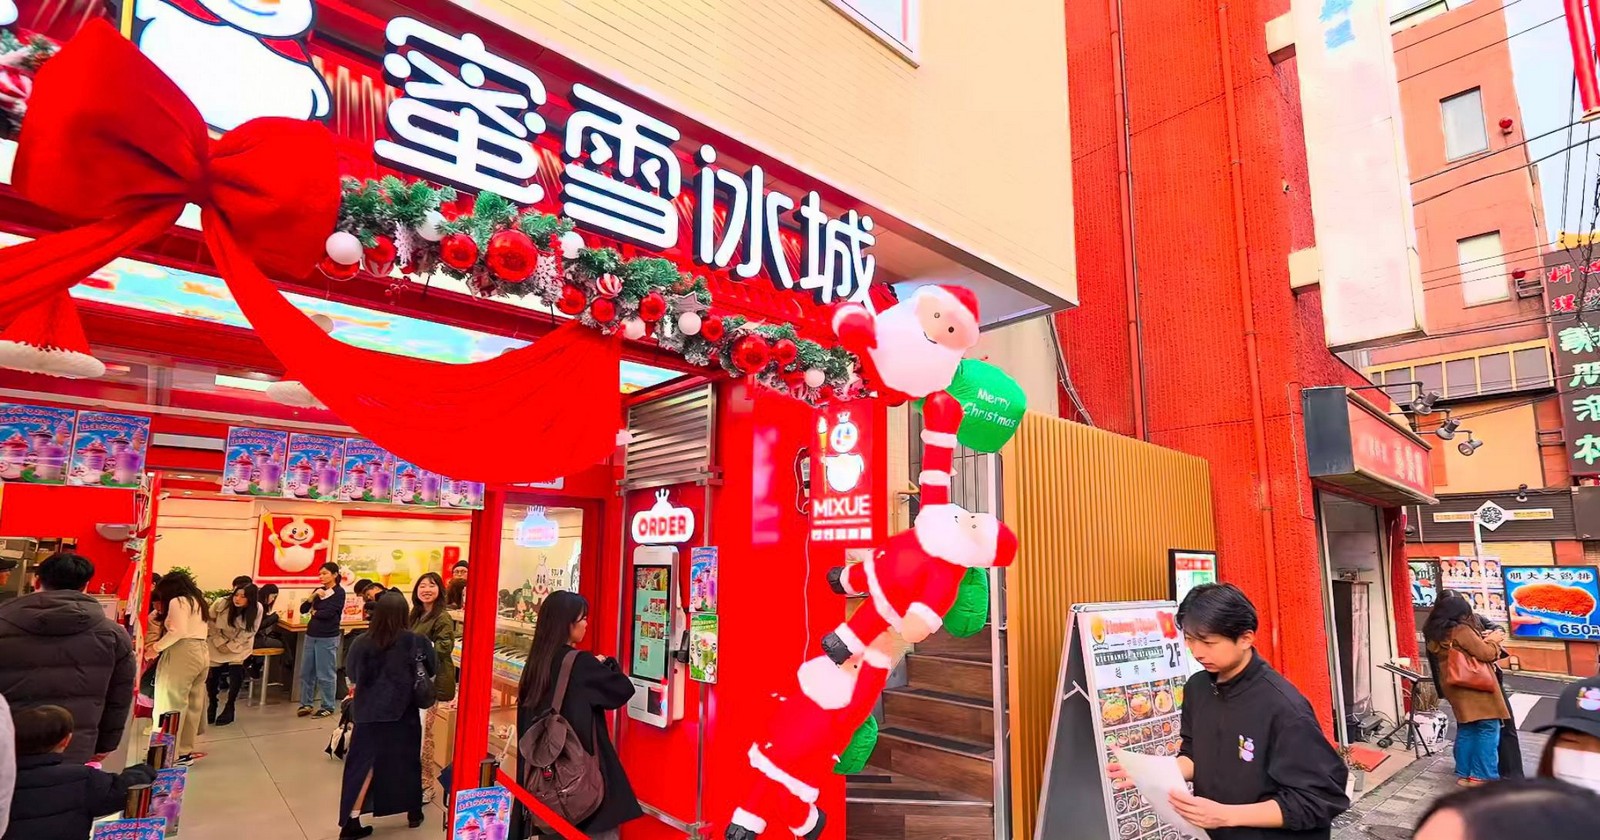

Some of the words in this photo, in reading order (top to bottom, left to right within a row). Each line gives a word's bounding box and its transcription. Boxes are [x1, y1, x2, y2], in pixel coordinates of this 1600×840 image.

[374, 16, 876, 318] 蜜雪冰城
[977, 387, 1011, 412] Merry
[963, 402, 1016, 428] Christmas
[813, 494, 871, 518] MIXUE
[638, 515, 687, 537] ORDER
